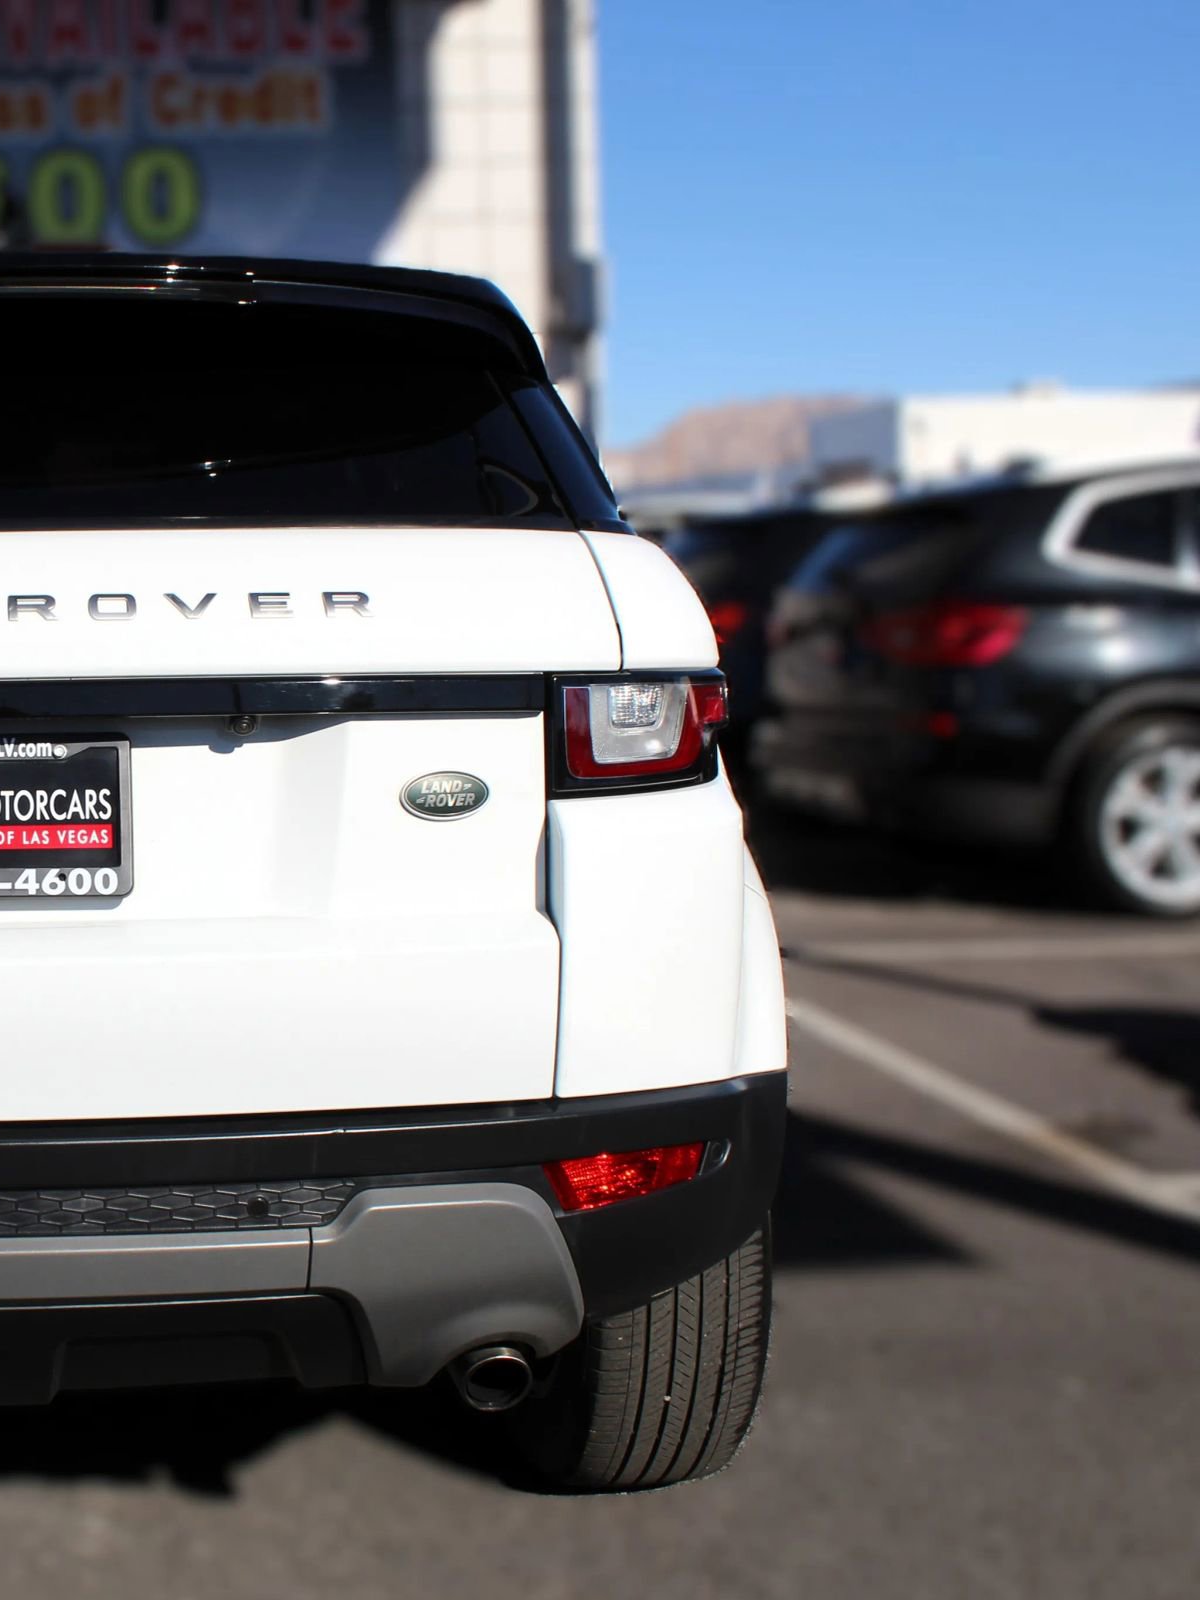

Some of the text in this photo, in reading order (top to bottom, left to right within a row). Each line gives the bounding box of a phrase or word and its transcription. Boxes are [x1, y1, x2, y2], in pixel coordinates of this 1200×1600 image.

[7, 591, 375, 622] ROVER
[421, 780, 462, 794] LAND
[424, 792, 475, 807] ROVER
[22, 829, 50, 845] LAS
[56, 827, 109, 845] VEGAS
